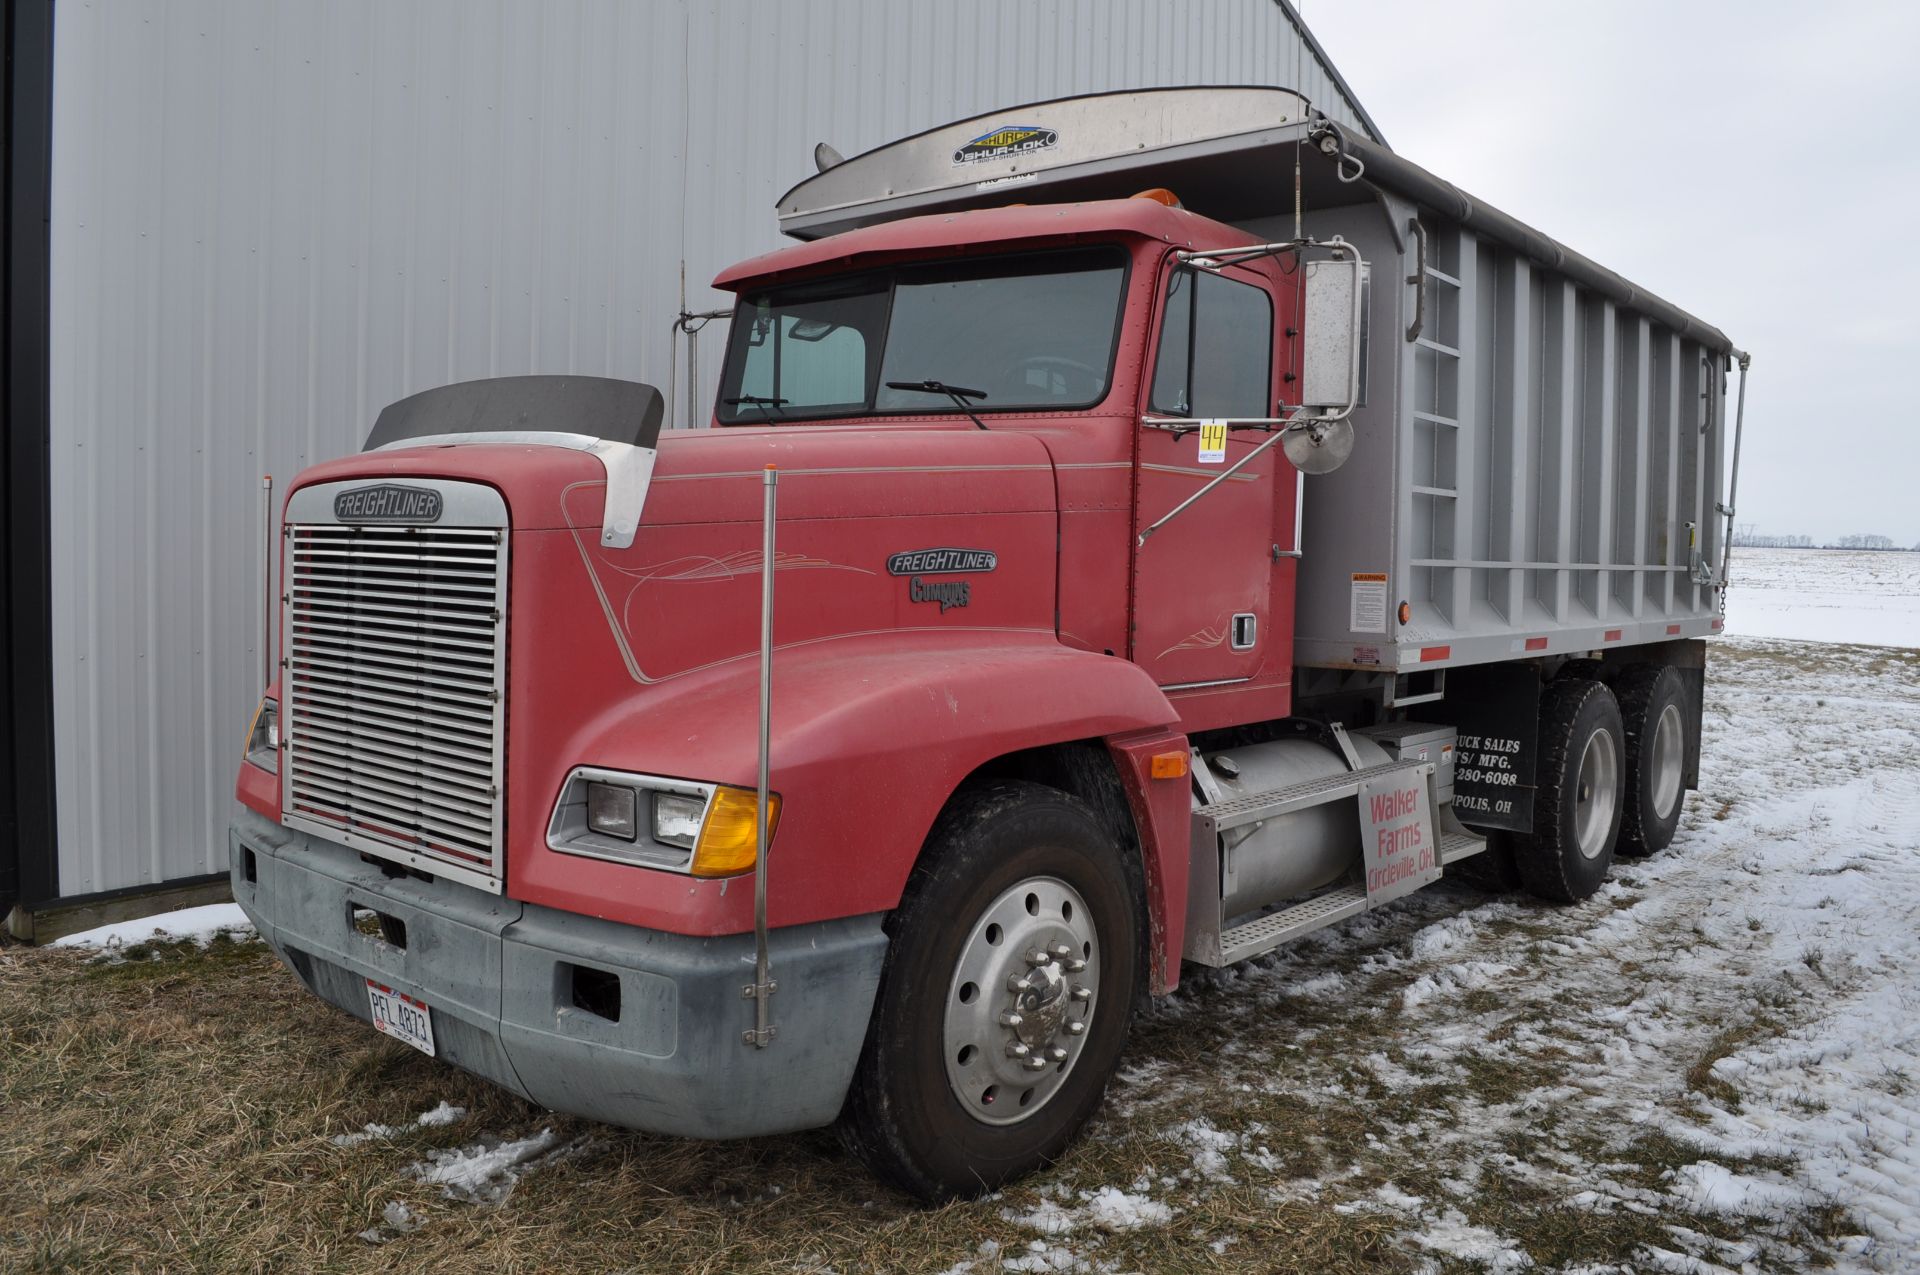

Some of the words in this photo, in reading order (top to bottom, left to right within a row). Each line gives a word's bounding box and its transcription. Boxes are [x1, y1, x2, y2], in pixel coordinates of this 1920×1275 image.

[964, 139, 1046, 160] SHUR-LOK
[1202, 425, 1224, 450] 44
[337, 490, 436, 515] FREIGHTLINER
[894, 552, 993, 571] FREIGHTLINER
[1484, 738, 1520, 753] SALES
[1478, 754, 1511, 769] MFG.
[1370, 789, 1418, 824] Walker
[1495, 800, 1512, 813] OH
[1377, 822, 1421, 858] Farms
[1368, 856, 1416, 892] Circleville,
[398, 1004, 427, 1040] 4873
